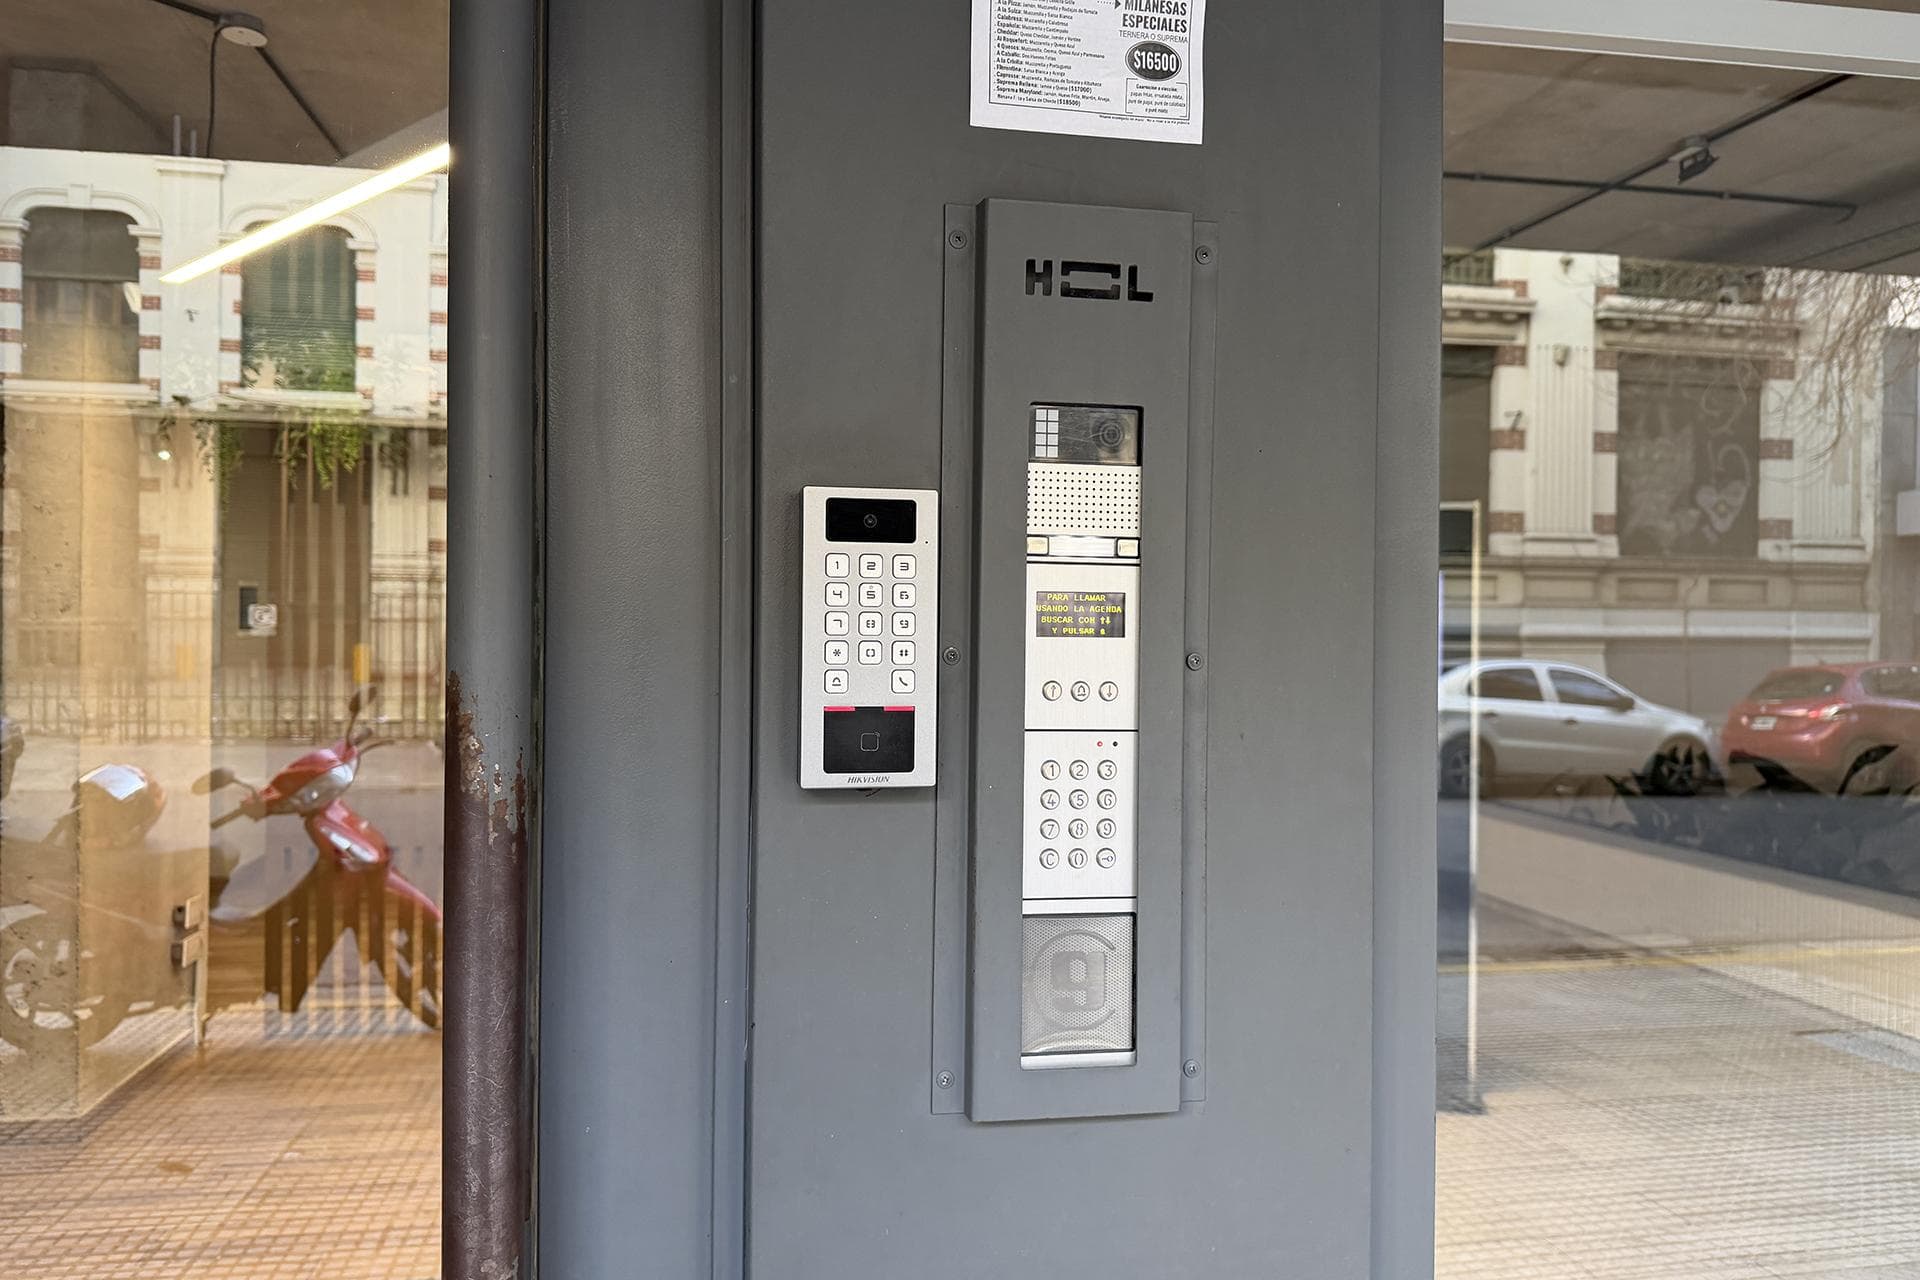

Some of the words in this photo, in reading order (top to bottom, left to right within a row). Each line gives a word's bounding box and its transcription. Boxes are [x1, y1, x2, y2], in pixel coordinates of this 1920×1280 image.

[1125, 0, 1188, 16] MILANESAS
[1122, 13, 1187, 33] ESPECIALES
[1119, 29, 1149, 40] TERNERA
[1150, 32, 1157, 41] O
[1157, 33, 1188, 44] SUPREMA
[1133, 48, 1177, 72] $16500
[866, 562, 876, 571] 2
[900, 562, 909, 571] 3
[833, 590, 842, 599] 4
[866, 590, 876, 600] 5
[900, 591, 909, 600] 6
[1047, 593, 1069, 602] PARA
[1074, 594, 1106, 602] LLAMAR
[833, 619, 842, 628] 7
[866, 620, 876, 629] 8
[900, 620, 909, 629] 9
[1063, 627, 1095, 635] PULSAR
[1050, 764, 1055, 777] 1
[1076, 764, 1084, 777] 2
[1105, 764, 1112, 777] 3
[847, 776, 890, 784] HIKVISION
[1047, 794, 1056, 807] 4
[1076, 794, 1084, 806] 5
[1104, 794, 1112, 806] 6
[1047, 824, 1055, 836] 7
[1076, 823, 1084, 836] 8
[1104, 823, 1112, 836] 9
[1046, 853, 1055, 866] C
[1075, 852, 1084, 866] 0
